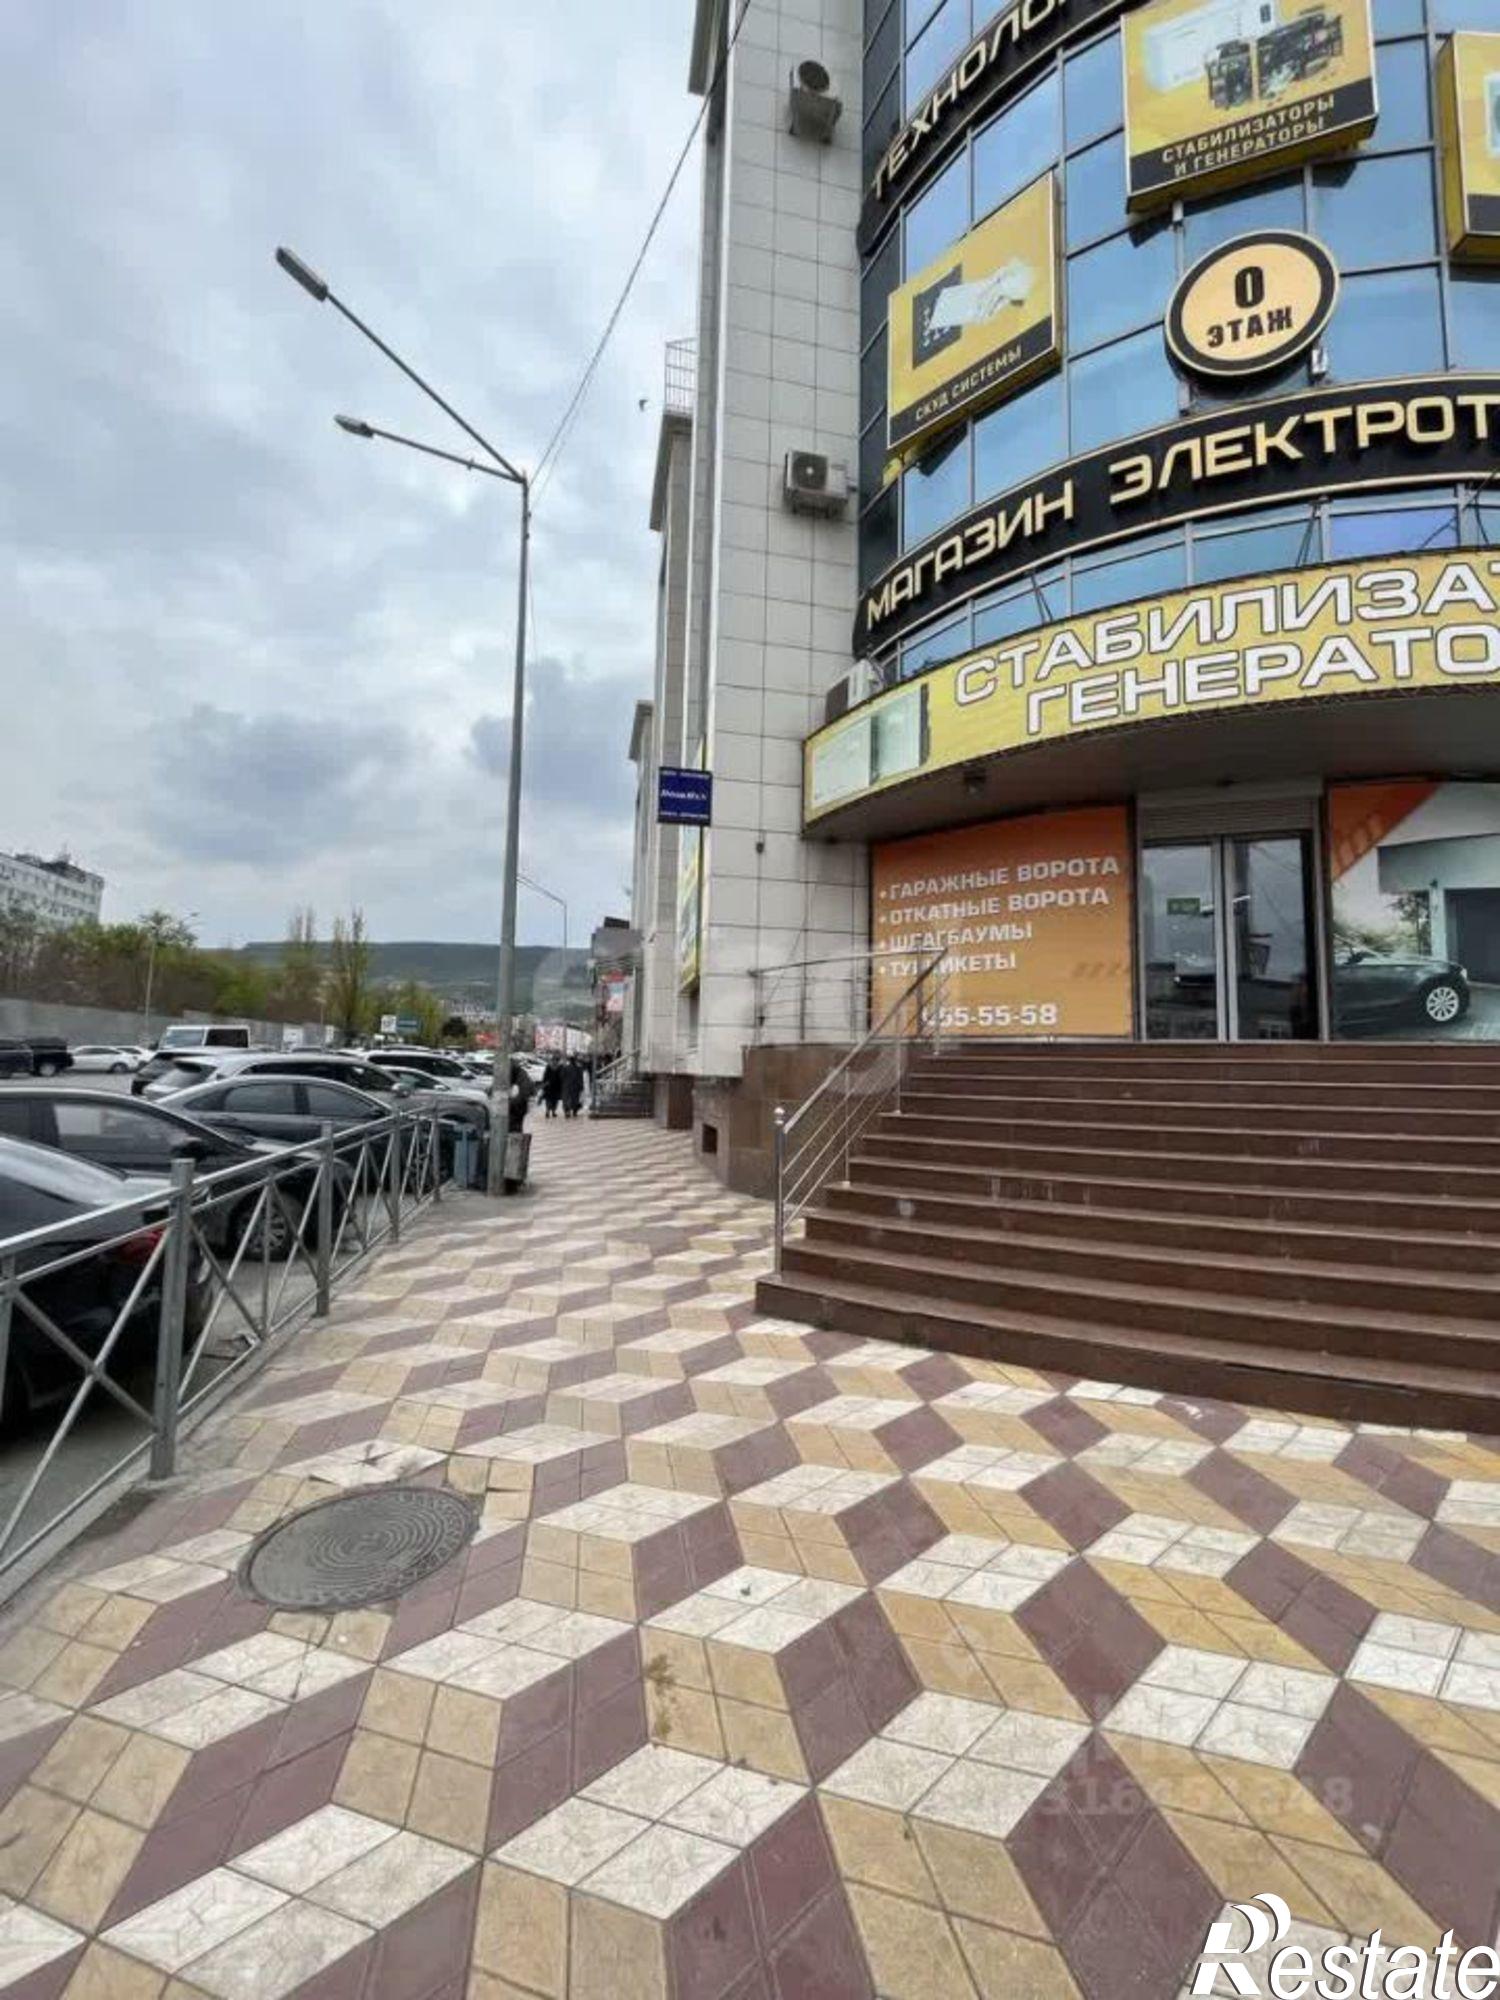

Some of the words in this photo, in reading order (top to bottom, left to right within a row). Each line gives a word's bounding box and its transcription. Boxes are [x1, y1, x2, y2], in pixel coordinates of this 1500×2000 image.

[872, 0, 1066, 198] ТЕХНОЛО
[1162, 94, 1335, 164] СТАБИЛИЗАТОРЫ
[1174, 159, 1187, 177] И
[1193, 116, 1325, 171] ГЕНЕРАТОРЫ
[1206, 306, 1293, 349] ЭТАЖ
[951, 344, 1022, 398] СИСТЕМЫ
[867, 480, 1074, 631] МАГАЗИН
[1108, 395, 1500, 505] ЭЛЕКТРОТ
[954, 560, 1500, 706] СТАБИЛИЗА
[1026, 623, 1500, 736] ГЕНЕРАТО
[889, 867, 1010, 900] ГАРАЖНЫЕ
[1017, 856, 1120, 882] ВОРОТА
[889, 897, 1001, 926] ОТКАТНЫЕ
[1008, 887, 1110, 911] ВОРОТА
